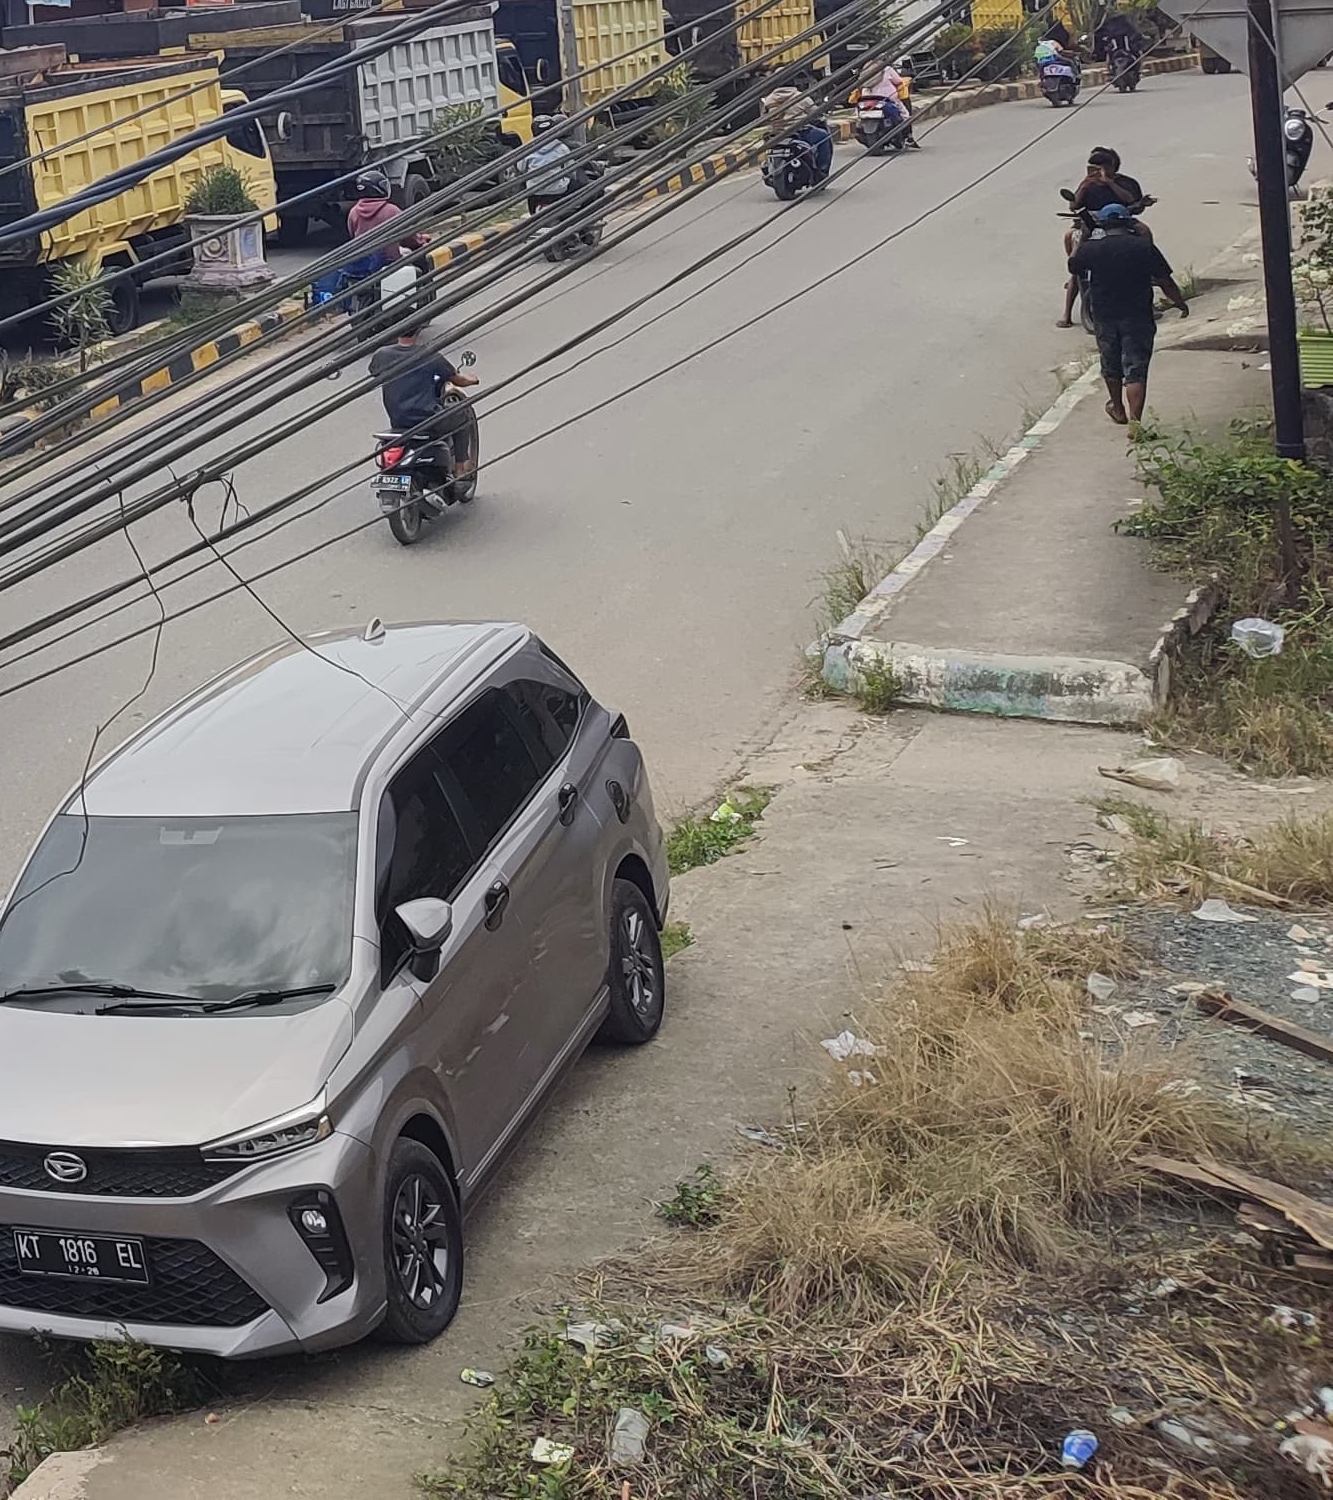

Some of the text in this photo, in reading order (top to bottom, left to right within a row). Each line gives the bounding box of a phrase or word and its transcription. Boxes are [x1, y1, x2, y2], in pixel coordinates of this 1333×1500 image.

[17, 1234, 142, 1268] KT 1816 EL
